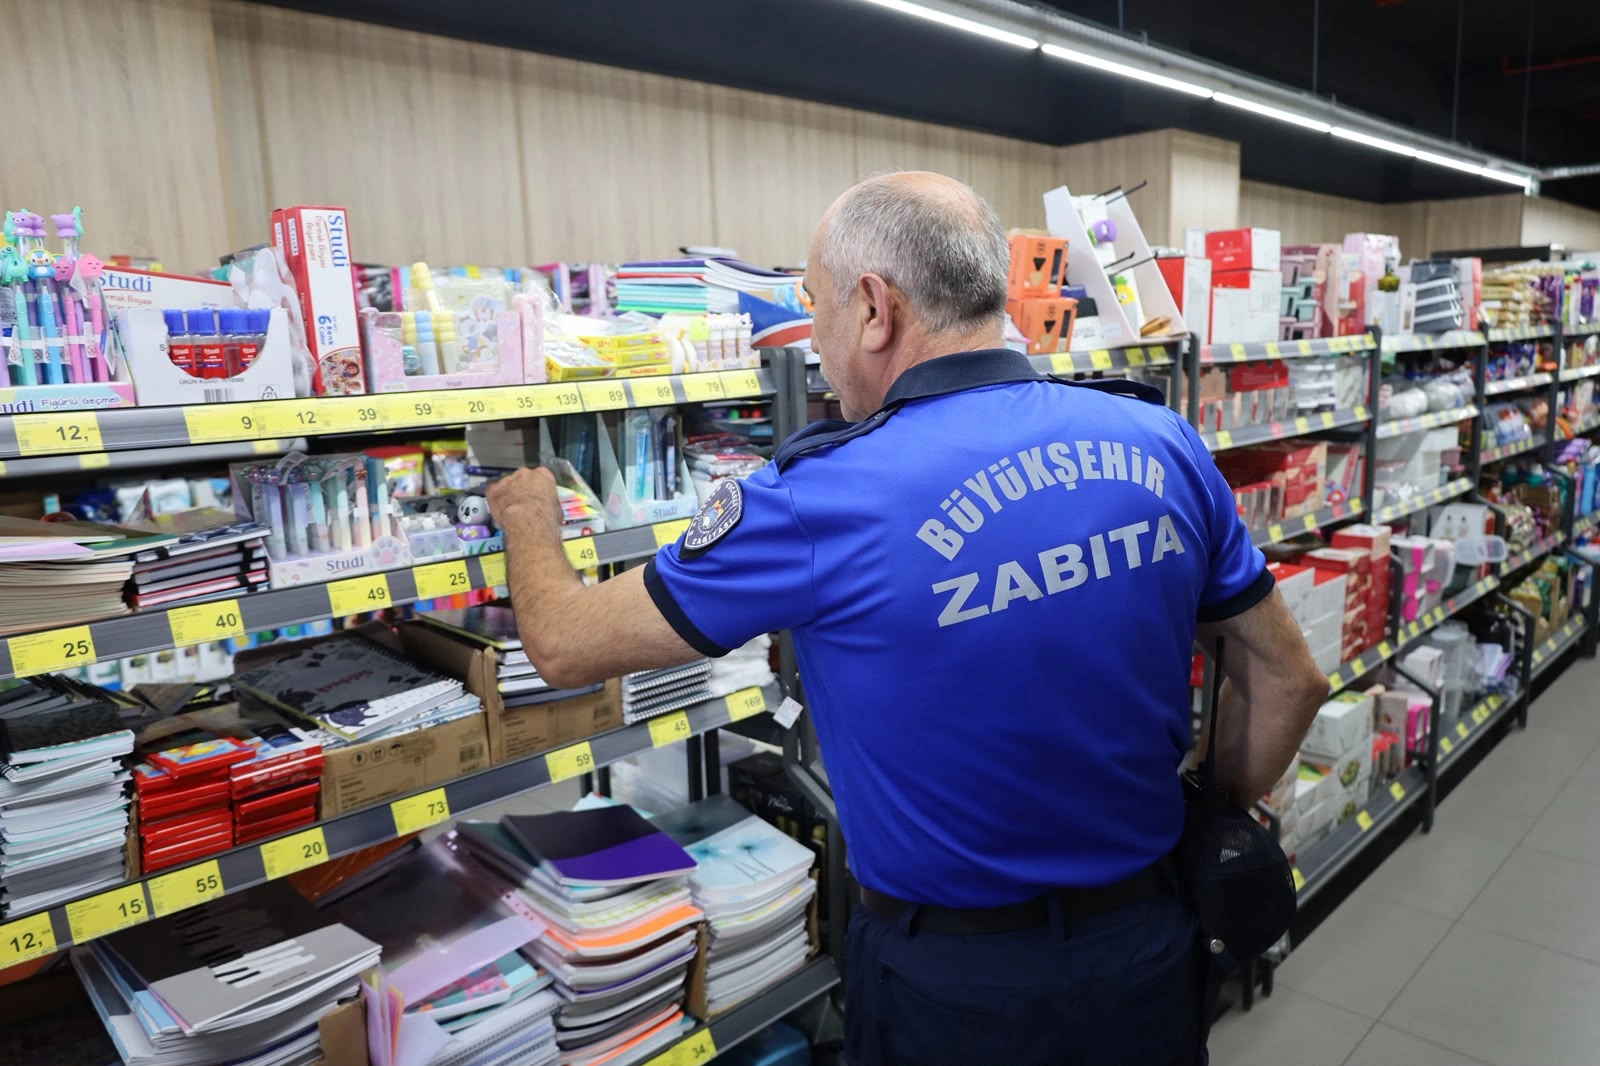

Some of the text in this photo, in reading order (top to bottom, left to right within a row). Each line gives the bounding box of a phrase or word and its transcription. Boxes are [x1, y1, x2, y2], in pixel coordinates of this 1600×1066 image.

[328, 214, 349, 268] Studi
[99, 271, 152, 292] Studi
[318, 315, 332, 325] 6
[517, 396, 533, 409] 35
[556, 393, 578, 406] 139
[609, 390, 623, 402] 89
[2, 399, 35, 413] udi
[415, 402, 432, 416] 59
[468, 400, 485, 413] 20
[296, 410, 317, 425] 12
[358, 408, 377, 421] 39
[241, 416, 252, 430] 9
[915, 440, 1165, 561] BÜYÜKŞEHİR
[653, 505, 678, 517] Studi
[579, 548, 594, 560] 49
[326, 555, 364, 571] Studi
[931, 514, 1186, 628] ZABITA
[449, 572, 467, 586] 25
[367, 586, 386, 601] 49
[215, 613, 237, 628] 40
[63, 640, 89, 658] 25
[674, 720, 687, 732] 45
[576, 753, 590, 767] 59
[427, 801, 446, 817] 73
[302, 841, 322, 859] 20
[196, 874, 219, 894] 55
[118, 898, 142, 918] 15
